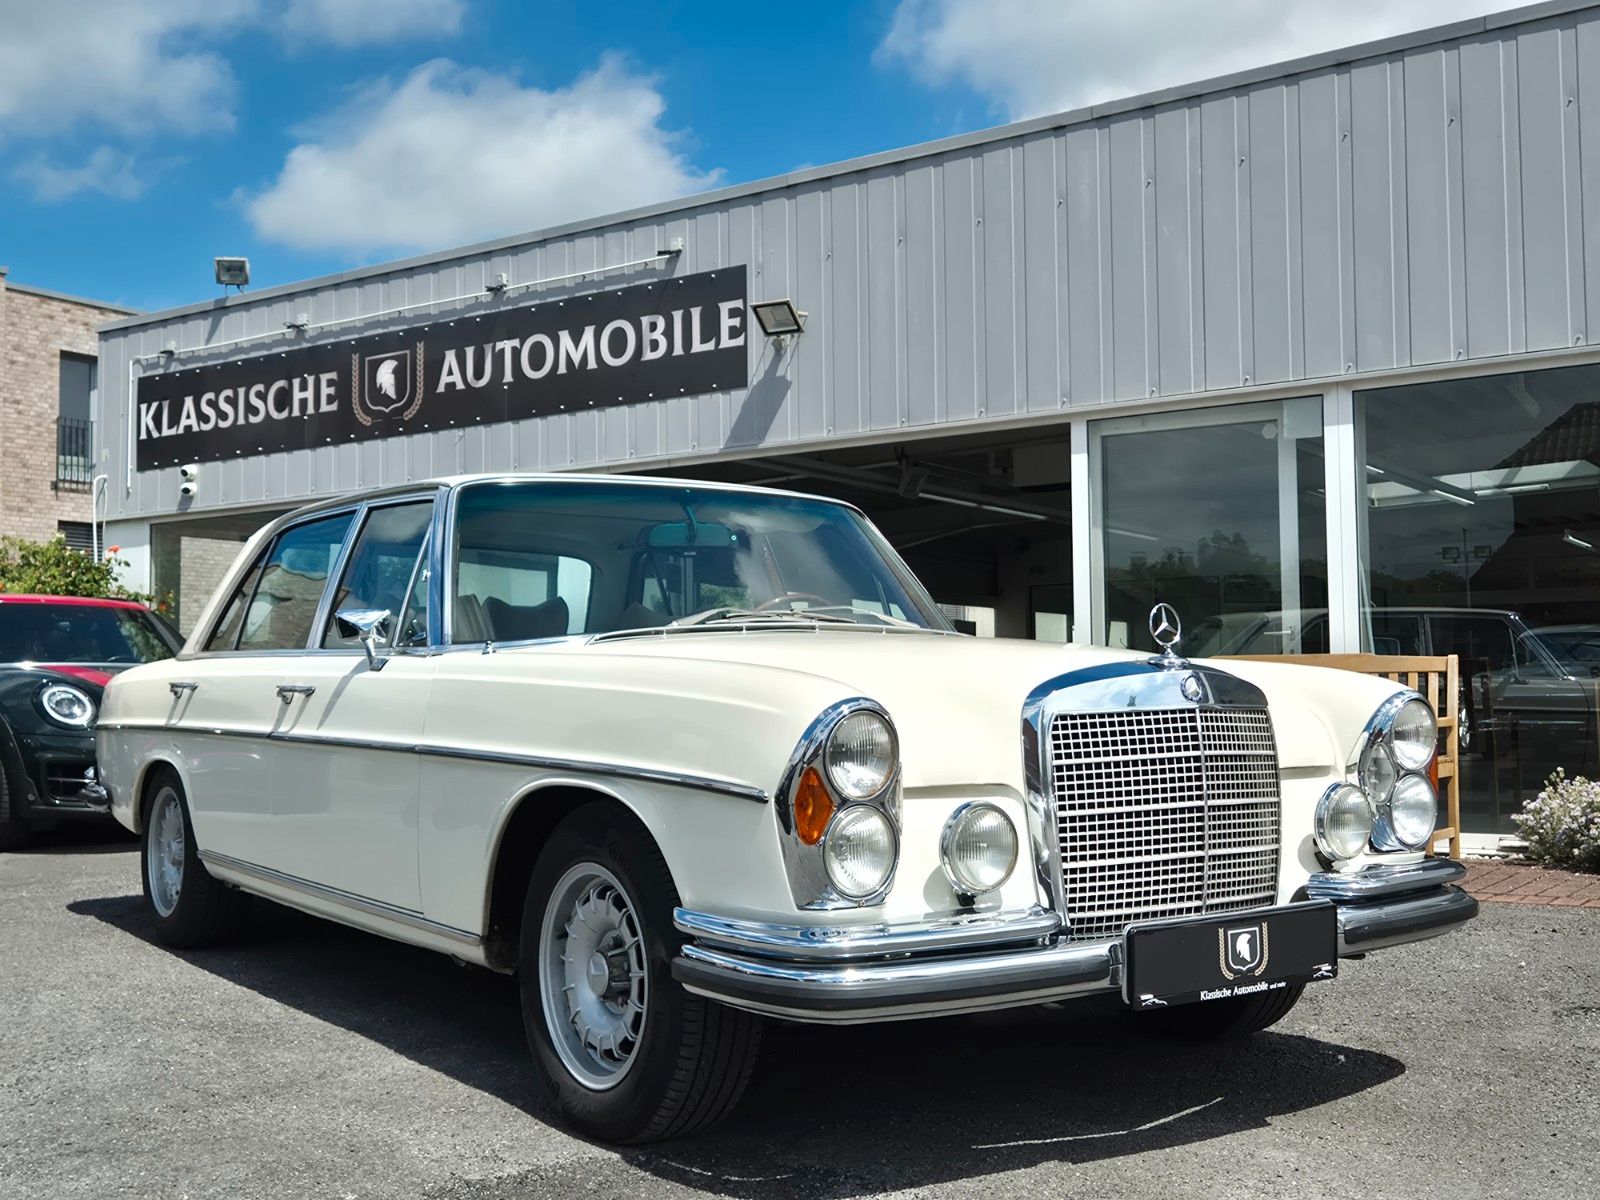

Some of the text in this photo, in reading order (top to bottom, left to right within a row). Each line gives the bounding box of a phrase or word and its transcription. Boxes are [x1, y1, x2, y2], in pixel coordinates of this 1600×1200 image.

[139, 299, 746, 440] KLASSISCHE AUTOMOBILE
[1200, 988, 1231, 1001] Klassische
[1233, 981, 1268, 995] Automobile
